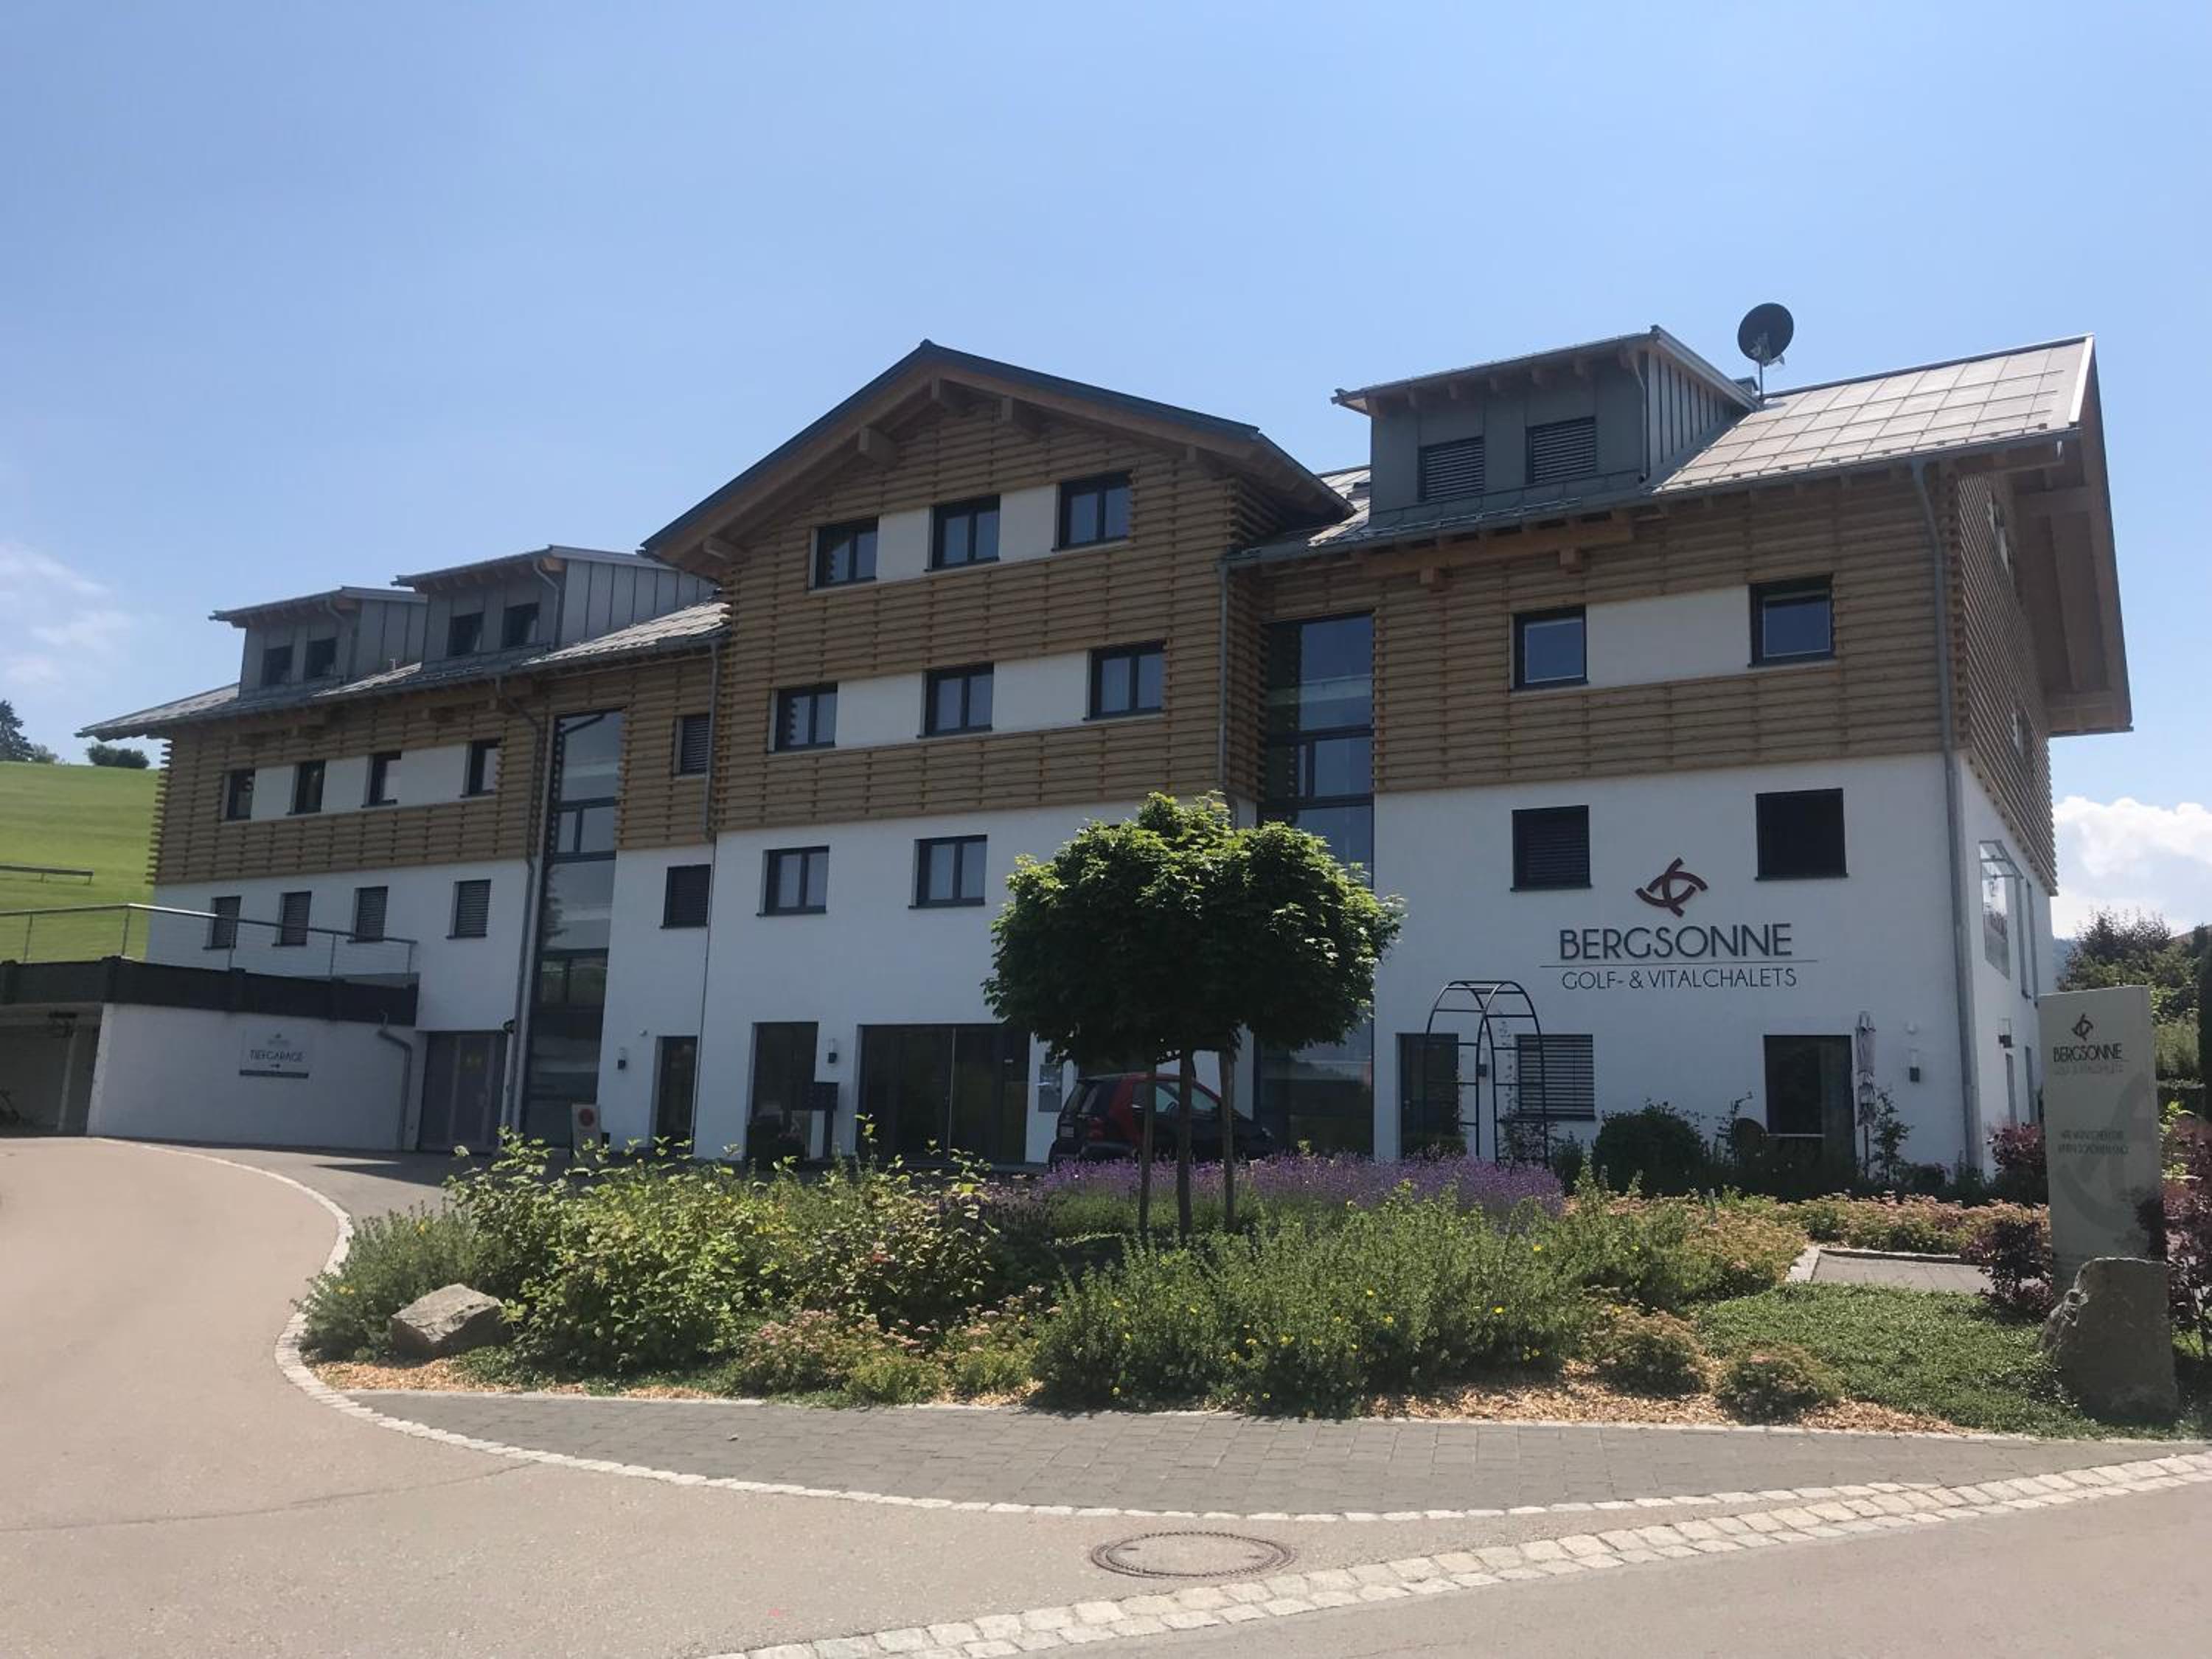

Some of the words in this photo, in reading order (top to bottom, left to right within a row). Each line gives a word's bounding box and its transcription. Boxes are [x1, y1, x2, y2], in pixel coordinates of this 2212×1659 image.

[1559, 923, 1792, 960] BERGSONNE
[1562, 970, 1623, 990] GOLF-
[1629, 970, 1644, 989] &
[1648, 967, 1797, 988] VITALCHALETS
[2053, 1043, 2122, 1062] BERGSONNE
